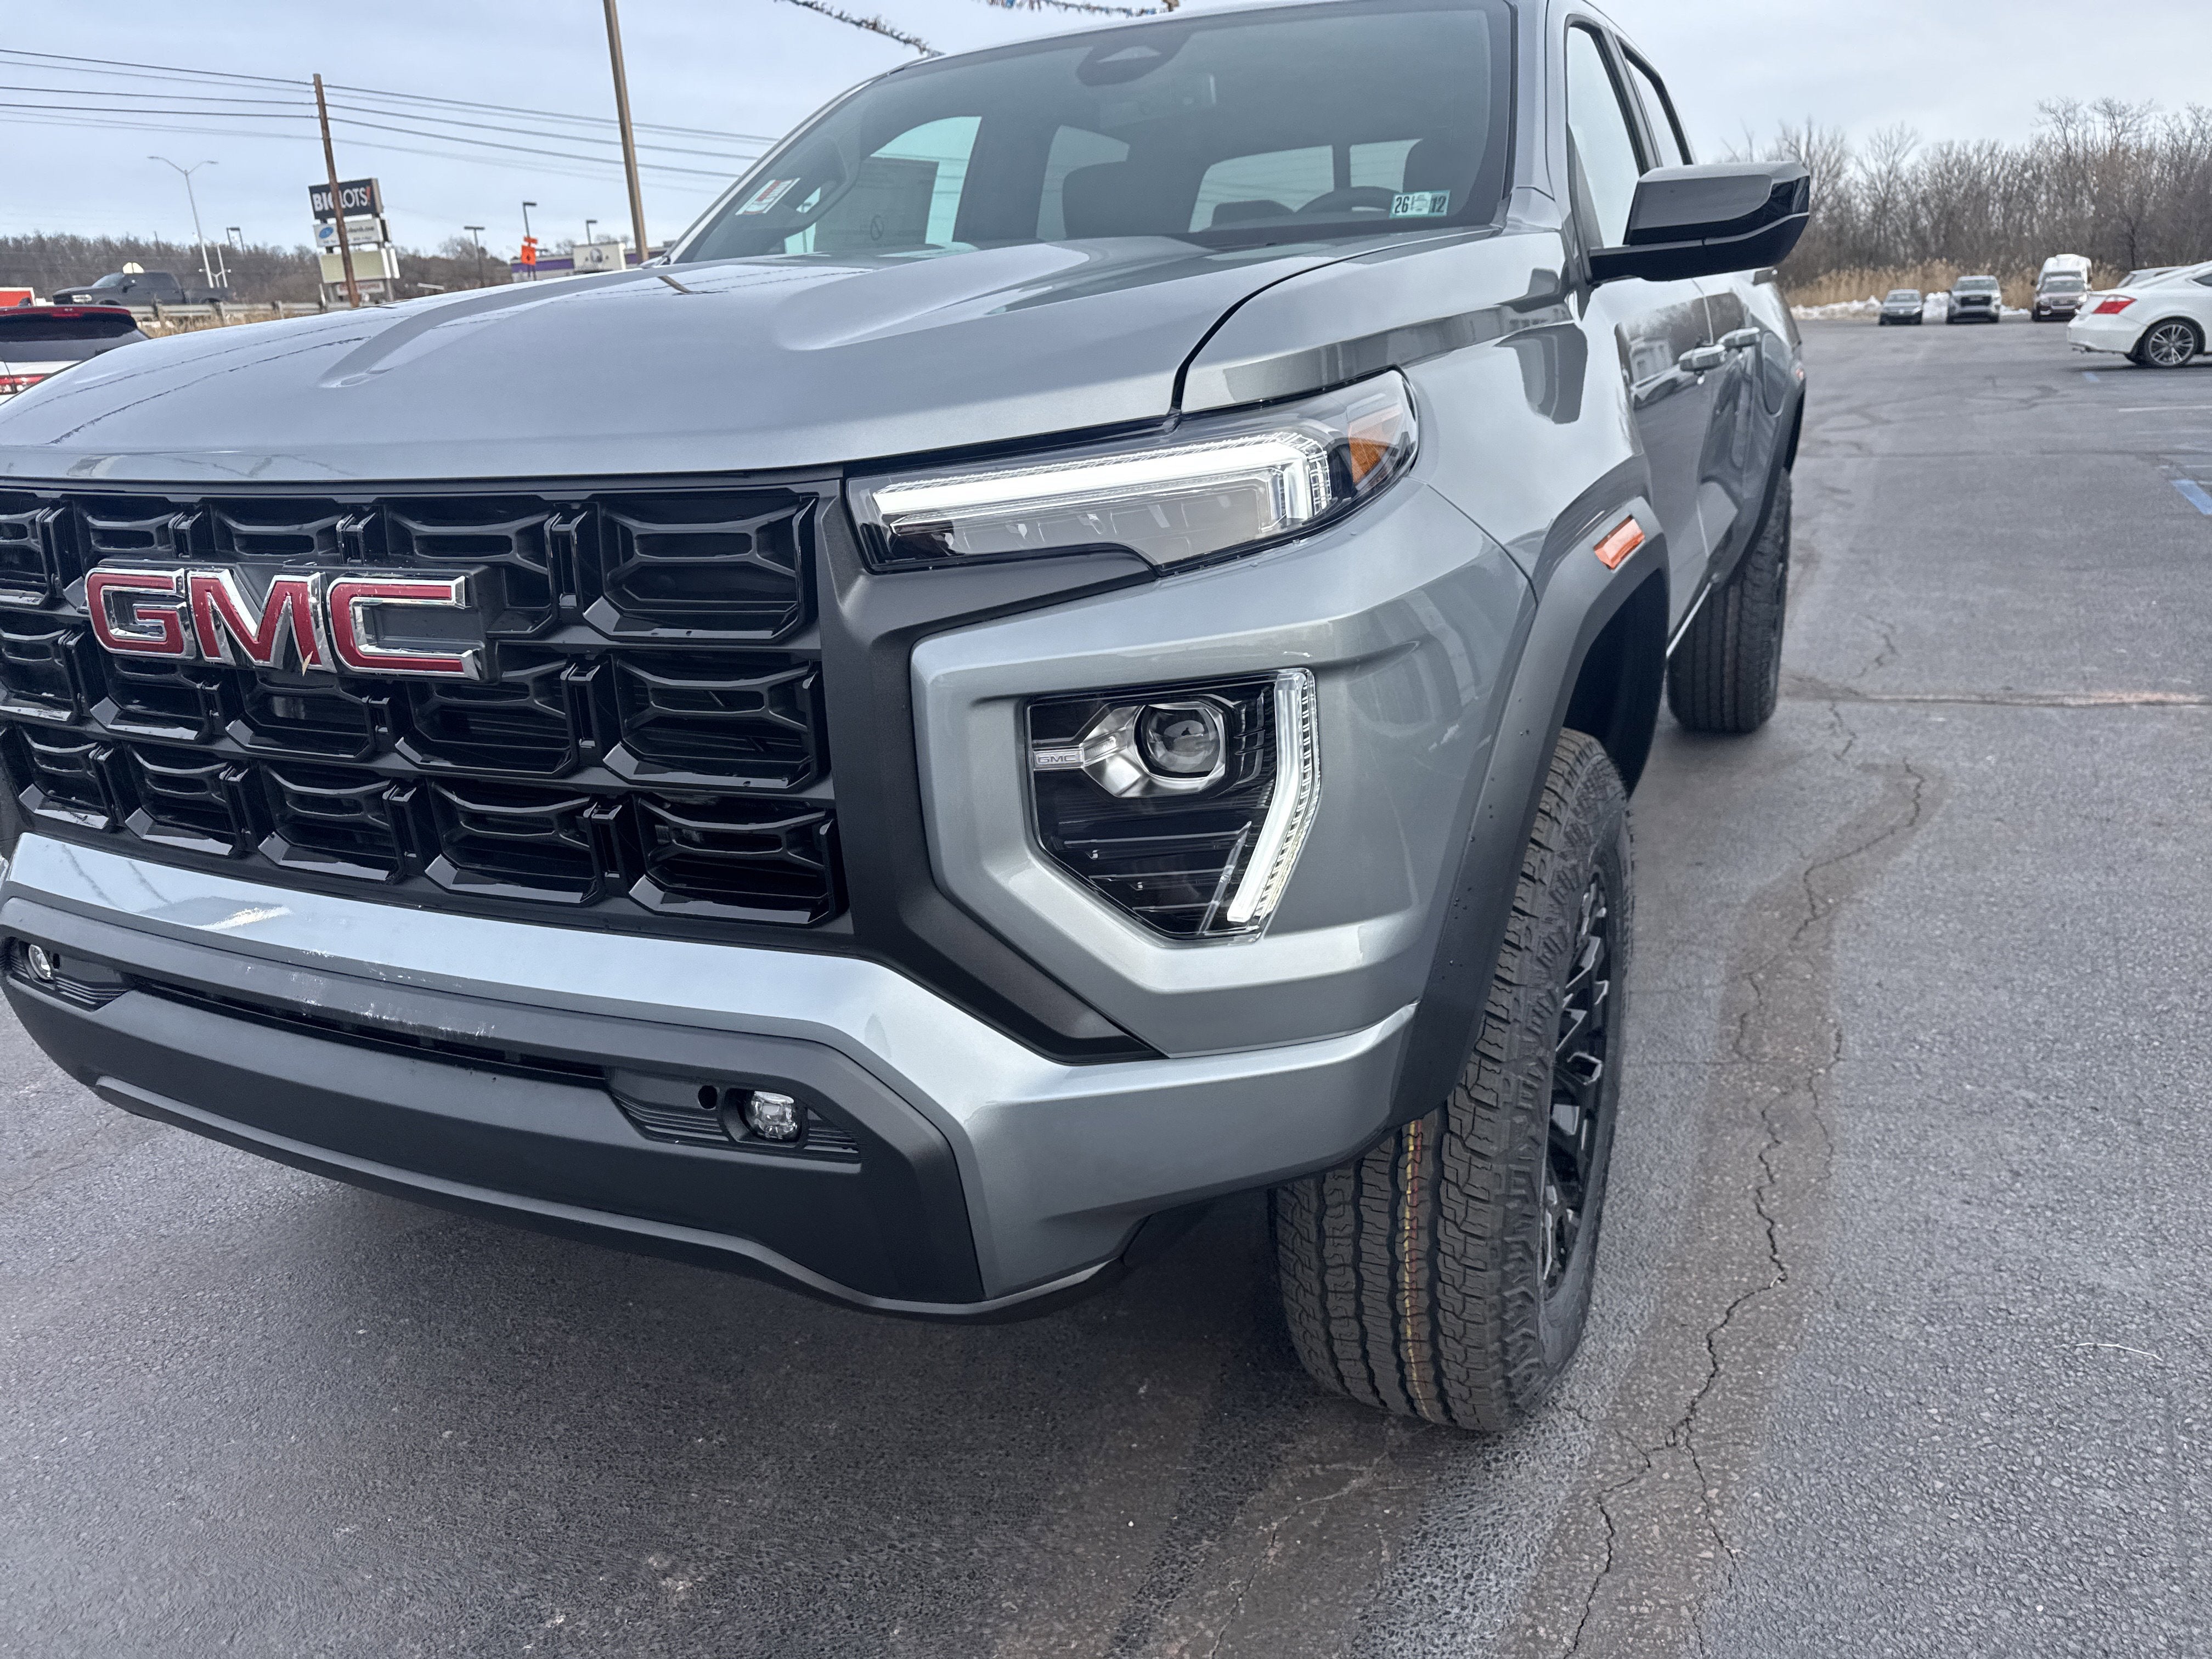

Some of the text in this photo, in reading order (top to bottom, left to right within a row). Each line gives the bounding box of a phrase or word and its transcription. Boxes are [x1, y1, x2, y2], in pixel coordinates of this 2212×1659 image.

[1395, 195, 1409, 213] 26
[1430, 195, 1446, 213] 12
[84, 567, 481, 681] GMC
[1037, 754, 1079, 763] GMC
